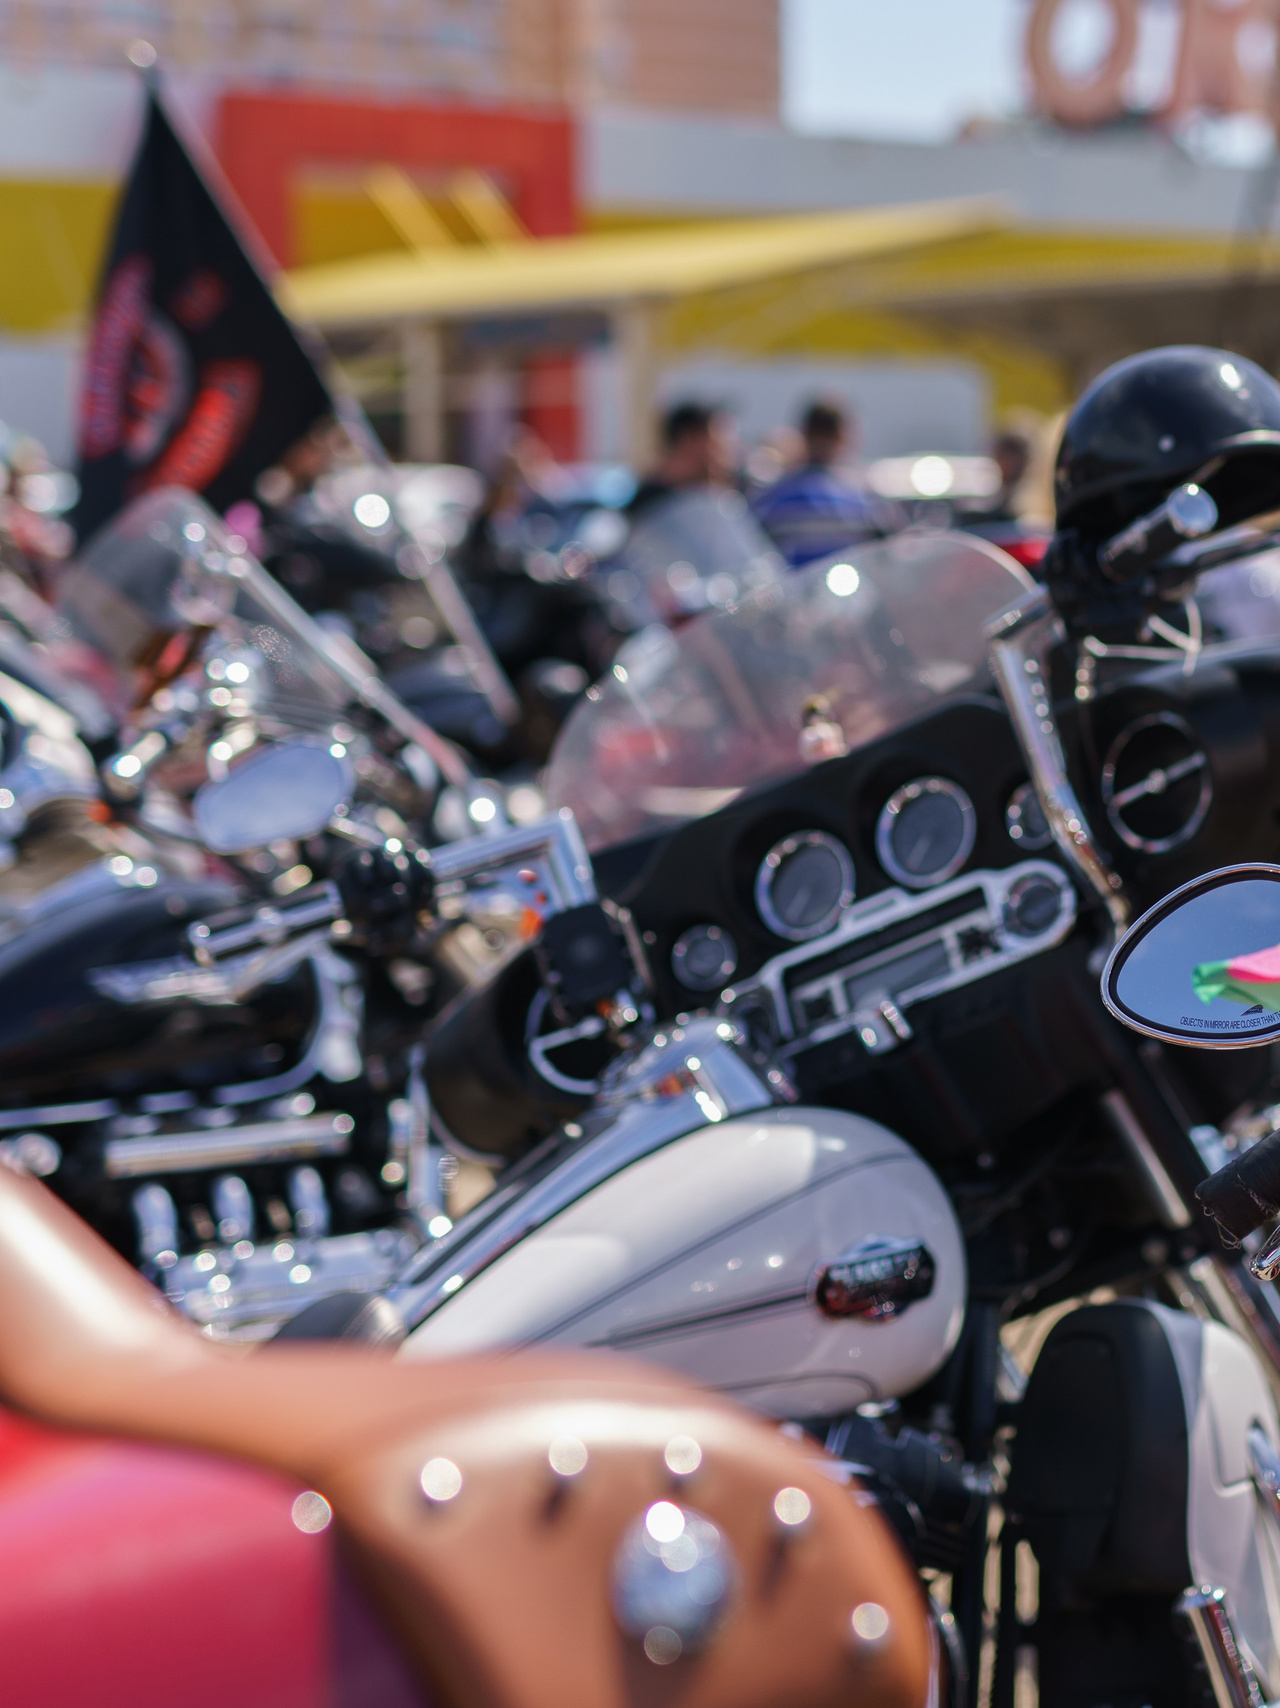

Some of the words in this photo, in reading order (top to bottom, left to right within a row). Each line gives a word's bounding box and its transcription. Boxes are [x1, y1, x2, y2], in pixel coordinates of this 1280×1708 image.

[1180, 1016, 1204, 1028] OBJECTS
[1204, 1020, 1210, 1028] IN
[1209, 1020, 1230, 1030] MIRROR
[1230, 1020, 1240, 1029] ARE
[1240, 1017, 1261, 1029] CLOSER
[1260, 1014, 1276, 1025] THAN
